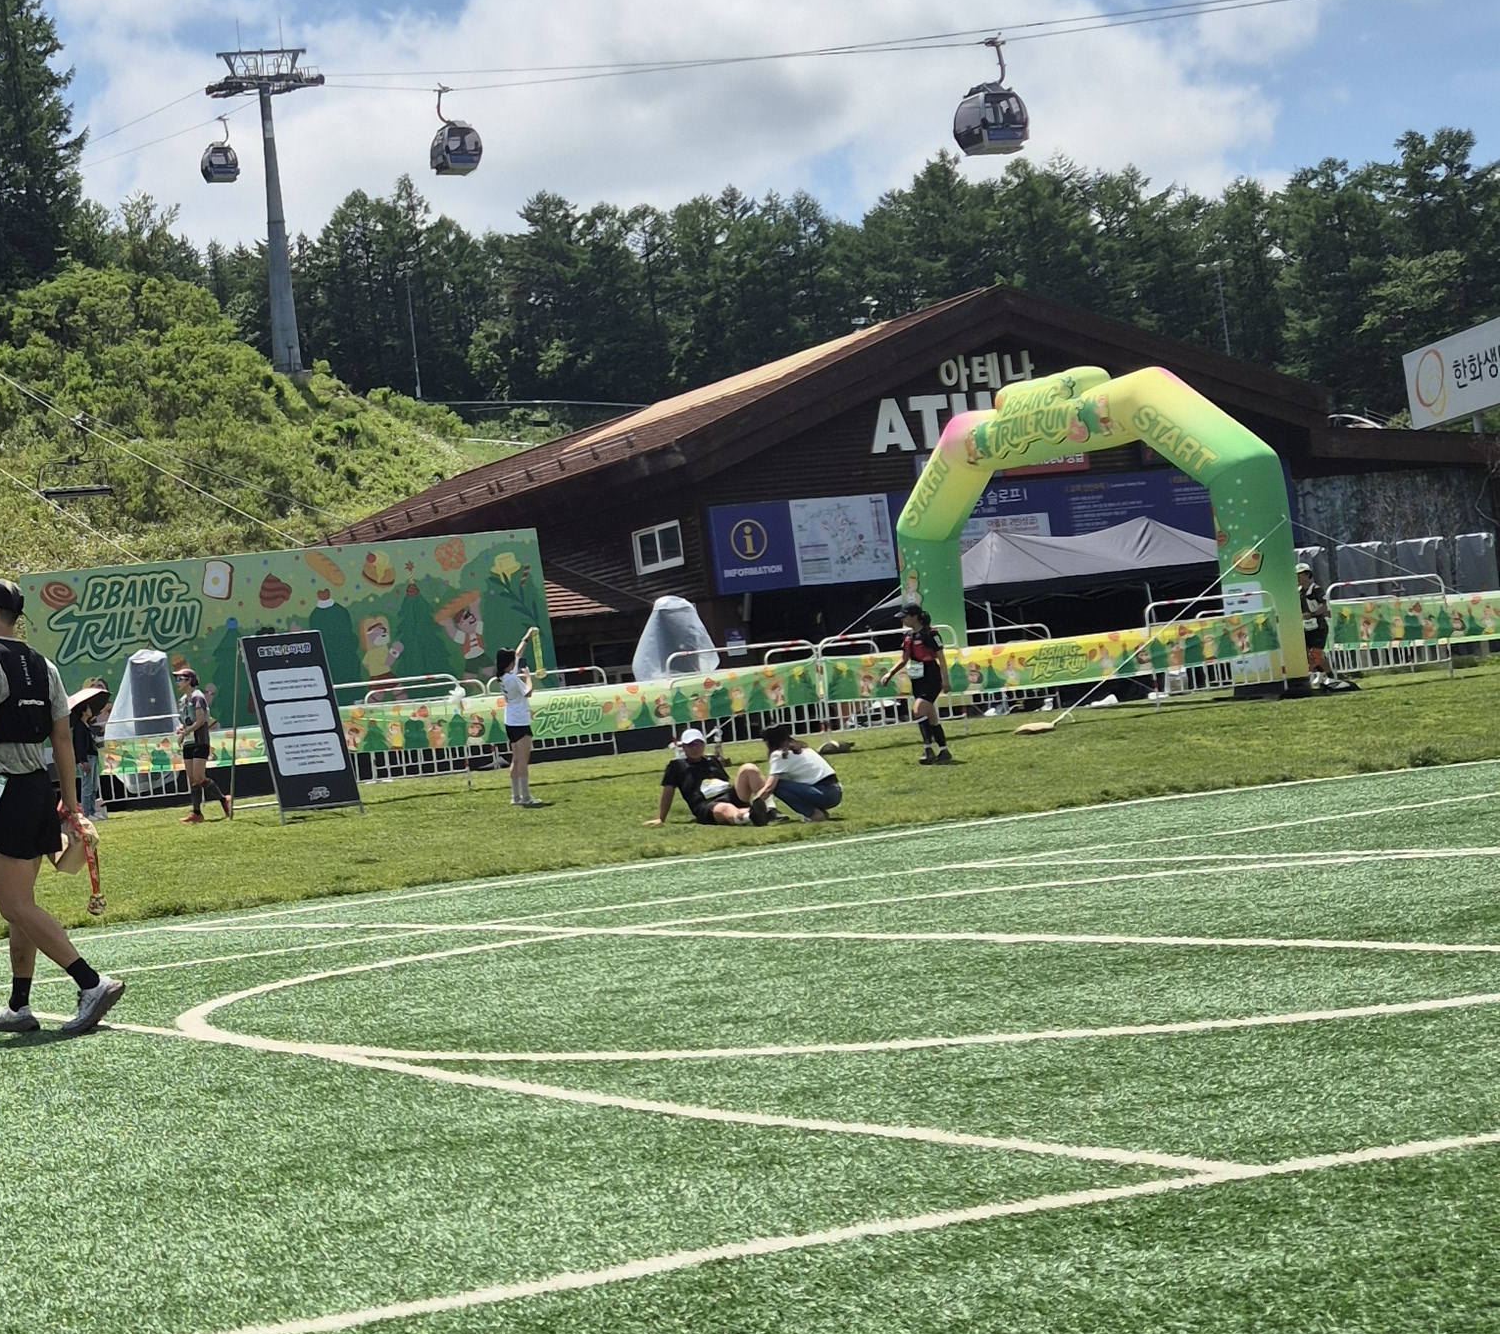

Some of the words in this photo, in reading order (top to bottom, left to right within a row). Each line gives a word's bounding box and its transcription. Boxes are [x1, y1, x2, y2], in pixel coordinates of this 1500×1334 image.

[940, 350, 1034, 391] 아테나
[1453, 345, 1500, 389] 한화생
[1003, 383, 1061, 417] BBANG
[991, 412, 1032, 453] TRAIL
[1033, 405, 1072, 441] RUN
[1133, 405, 1219, 472] START
[905, 446, 950, 526] START
[986, 488, 1022, 506] 슬로프
[723, 564, 783, 578] INFORMATION
[85, 576, 183, 612] BBANG
[53, 610, 136, 659] TRAIL
[139, 605, 196, 645] RUN
[1039, 642, 1080, 659] BBANG
[550, 696, 591, 711] BBANG
[575, 707, 601, 726] RUN
